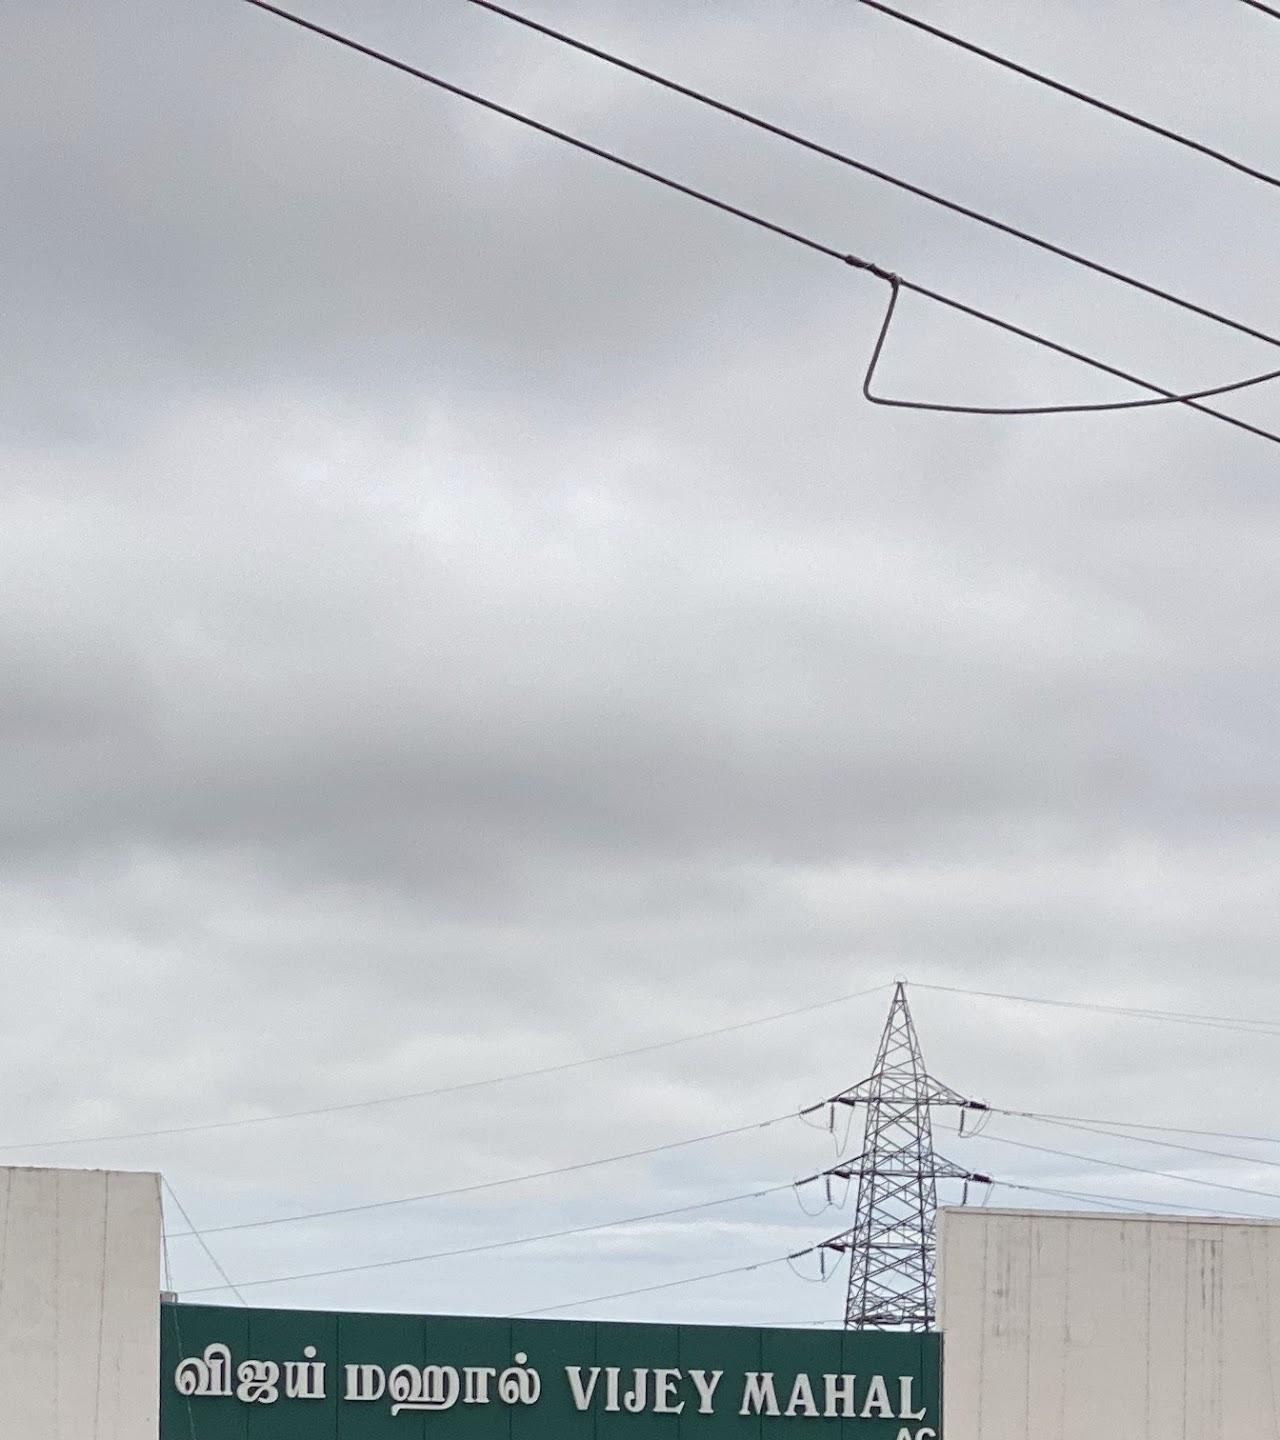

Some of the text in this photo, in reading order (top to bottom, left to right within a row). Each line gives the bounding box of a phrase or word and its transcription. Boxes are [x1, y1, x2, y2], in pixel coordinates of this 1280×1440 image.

[174, 1342, 542, 1416] விஜய் மஹால்
[564, 1366, 927, 1421] VIJEY MAHAL
